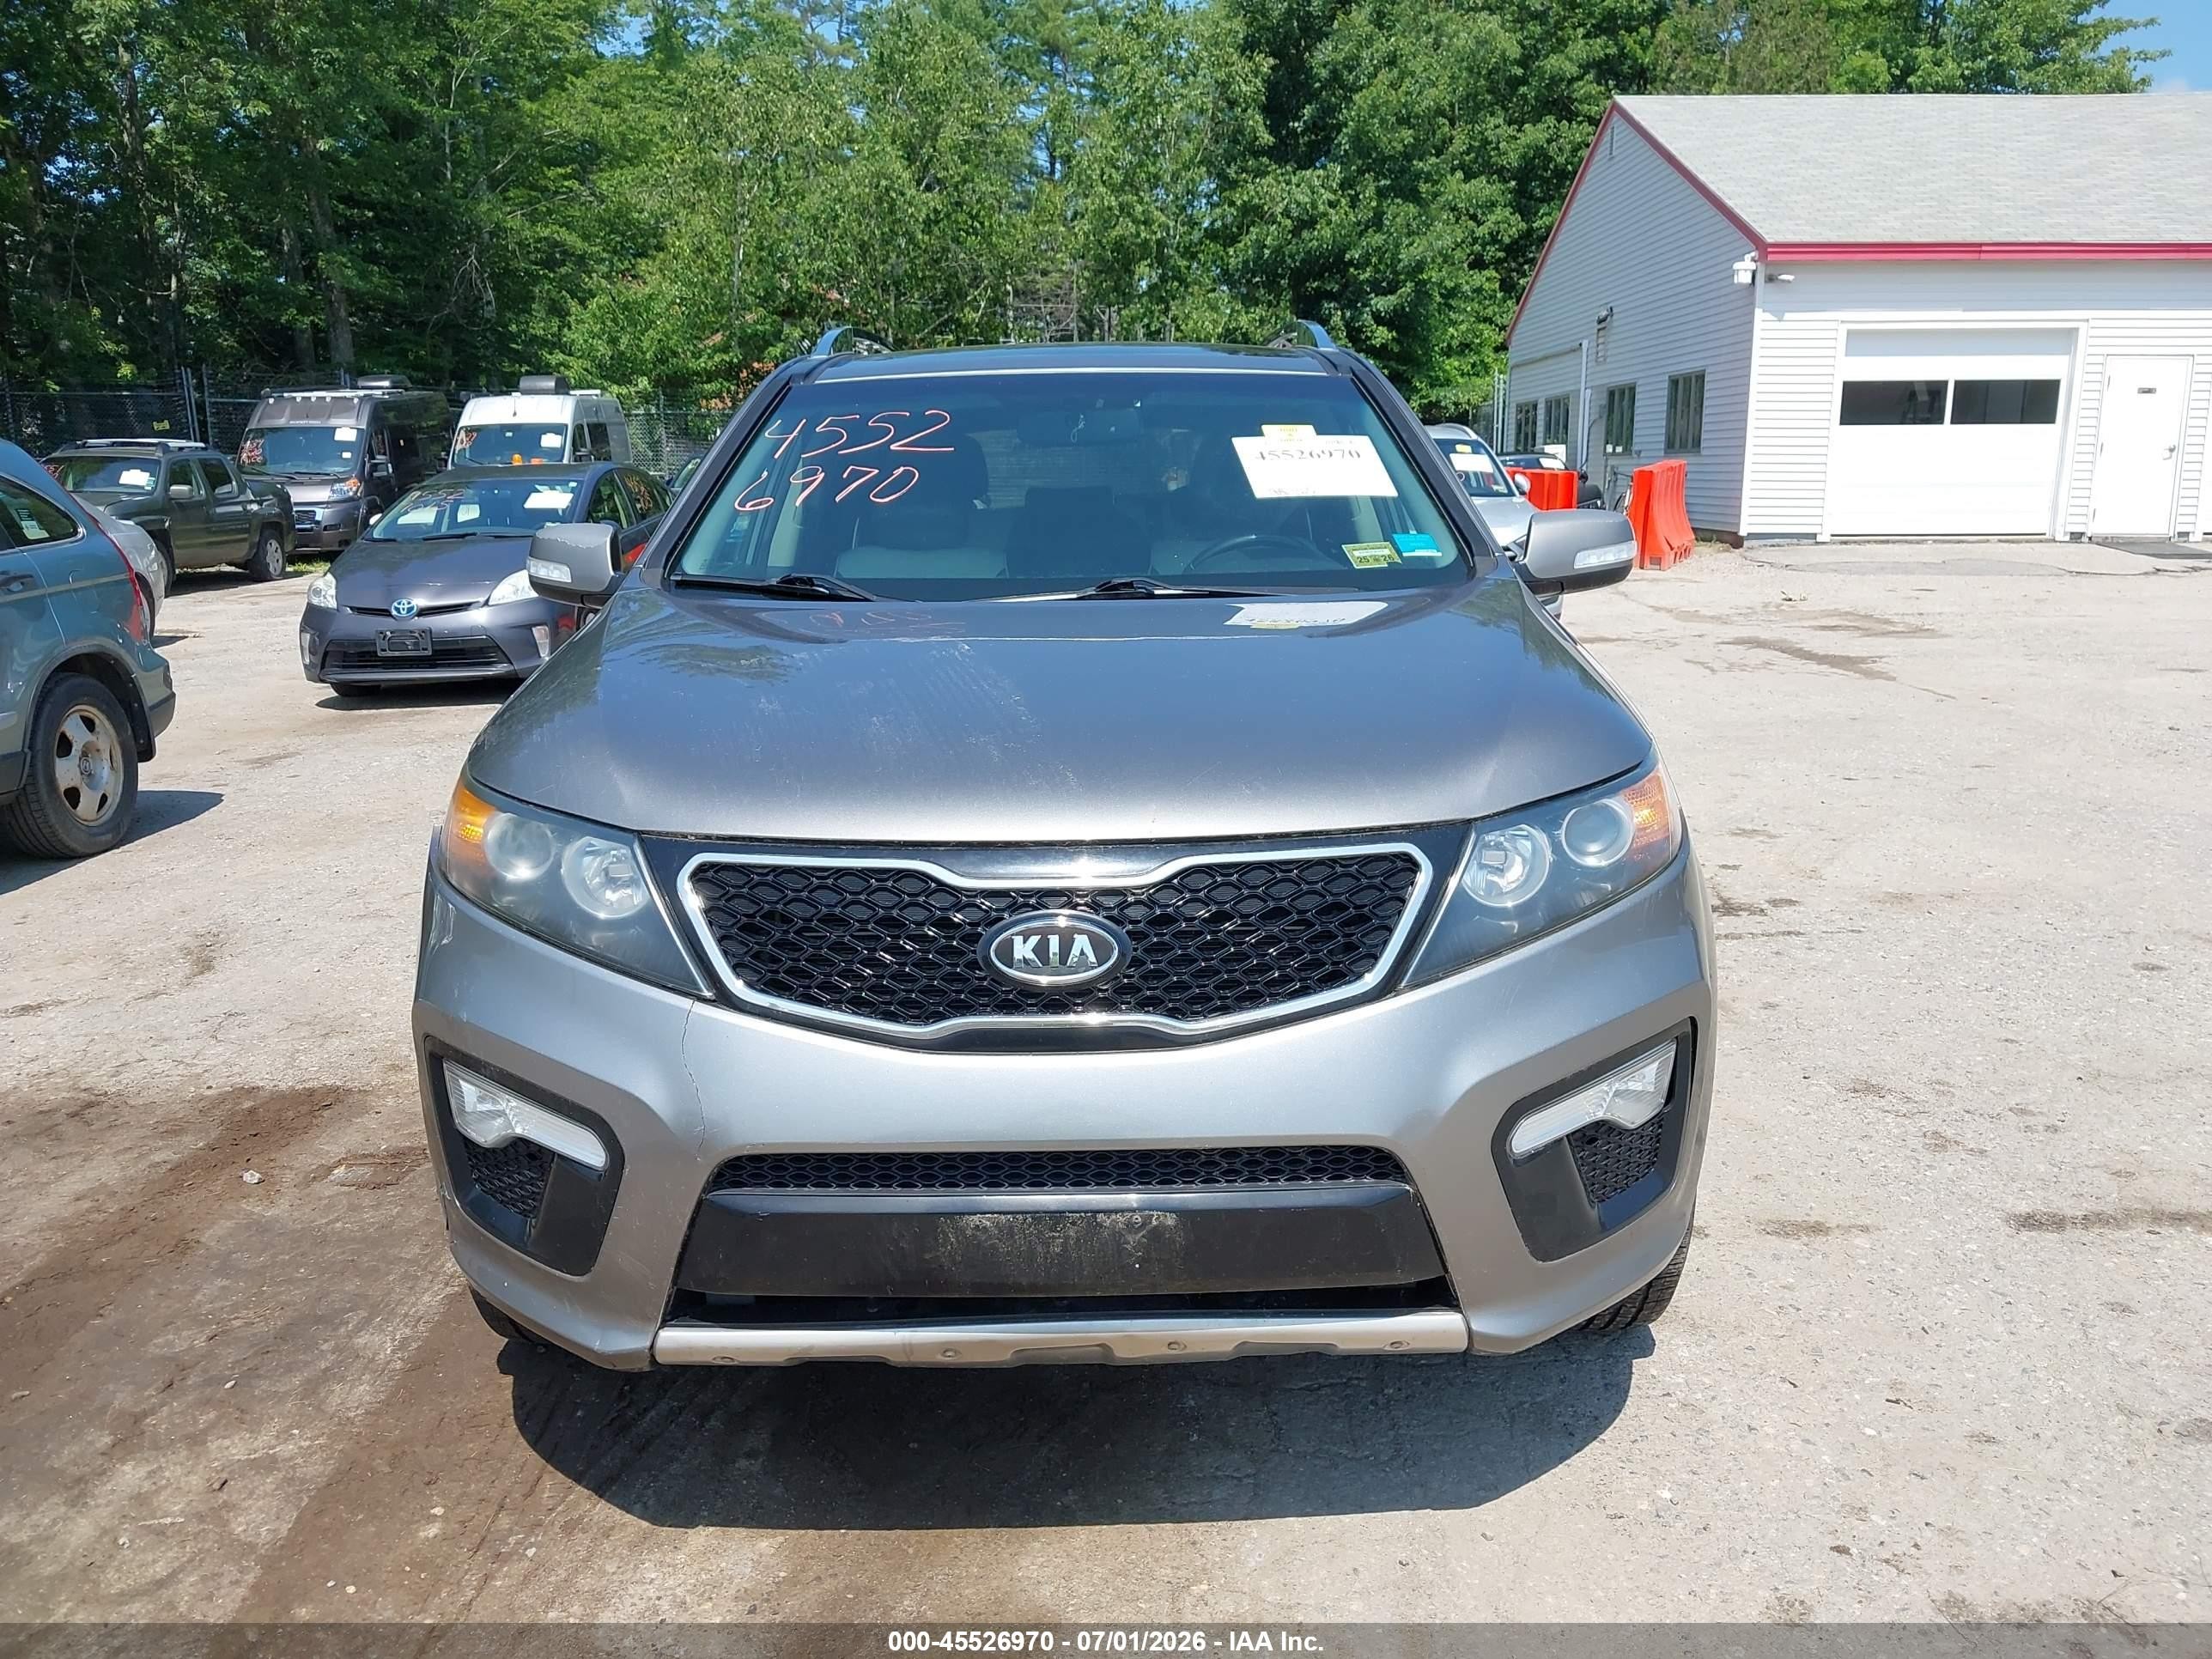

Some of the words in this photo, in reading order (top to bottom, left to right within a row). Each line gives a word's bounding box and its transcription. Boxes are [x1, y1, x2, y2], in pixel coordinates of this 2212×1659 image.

[764, 409, 956, 459] 4552
[733, 465, 920, 512] 6970
[1357, 556, 1370, 564] 25
[1012, 933, 1098, 969] KIA
